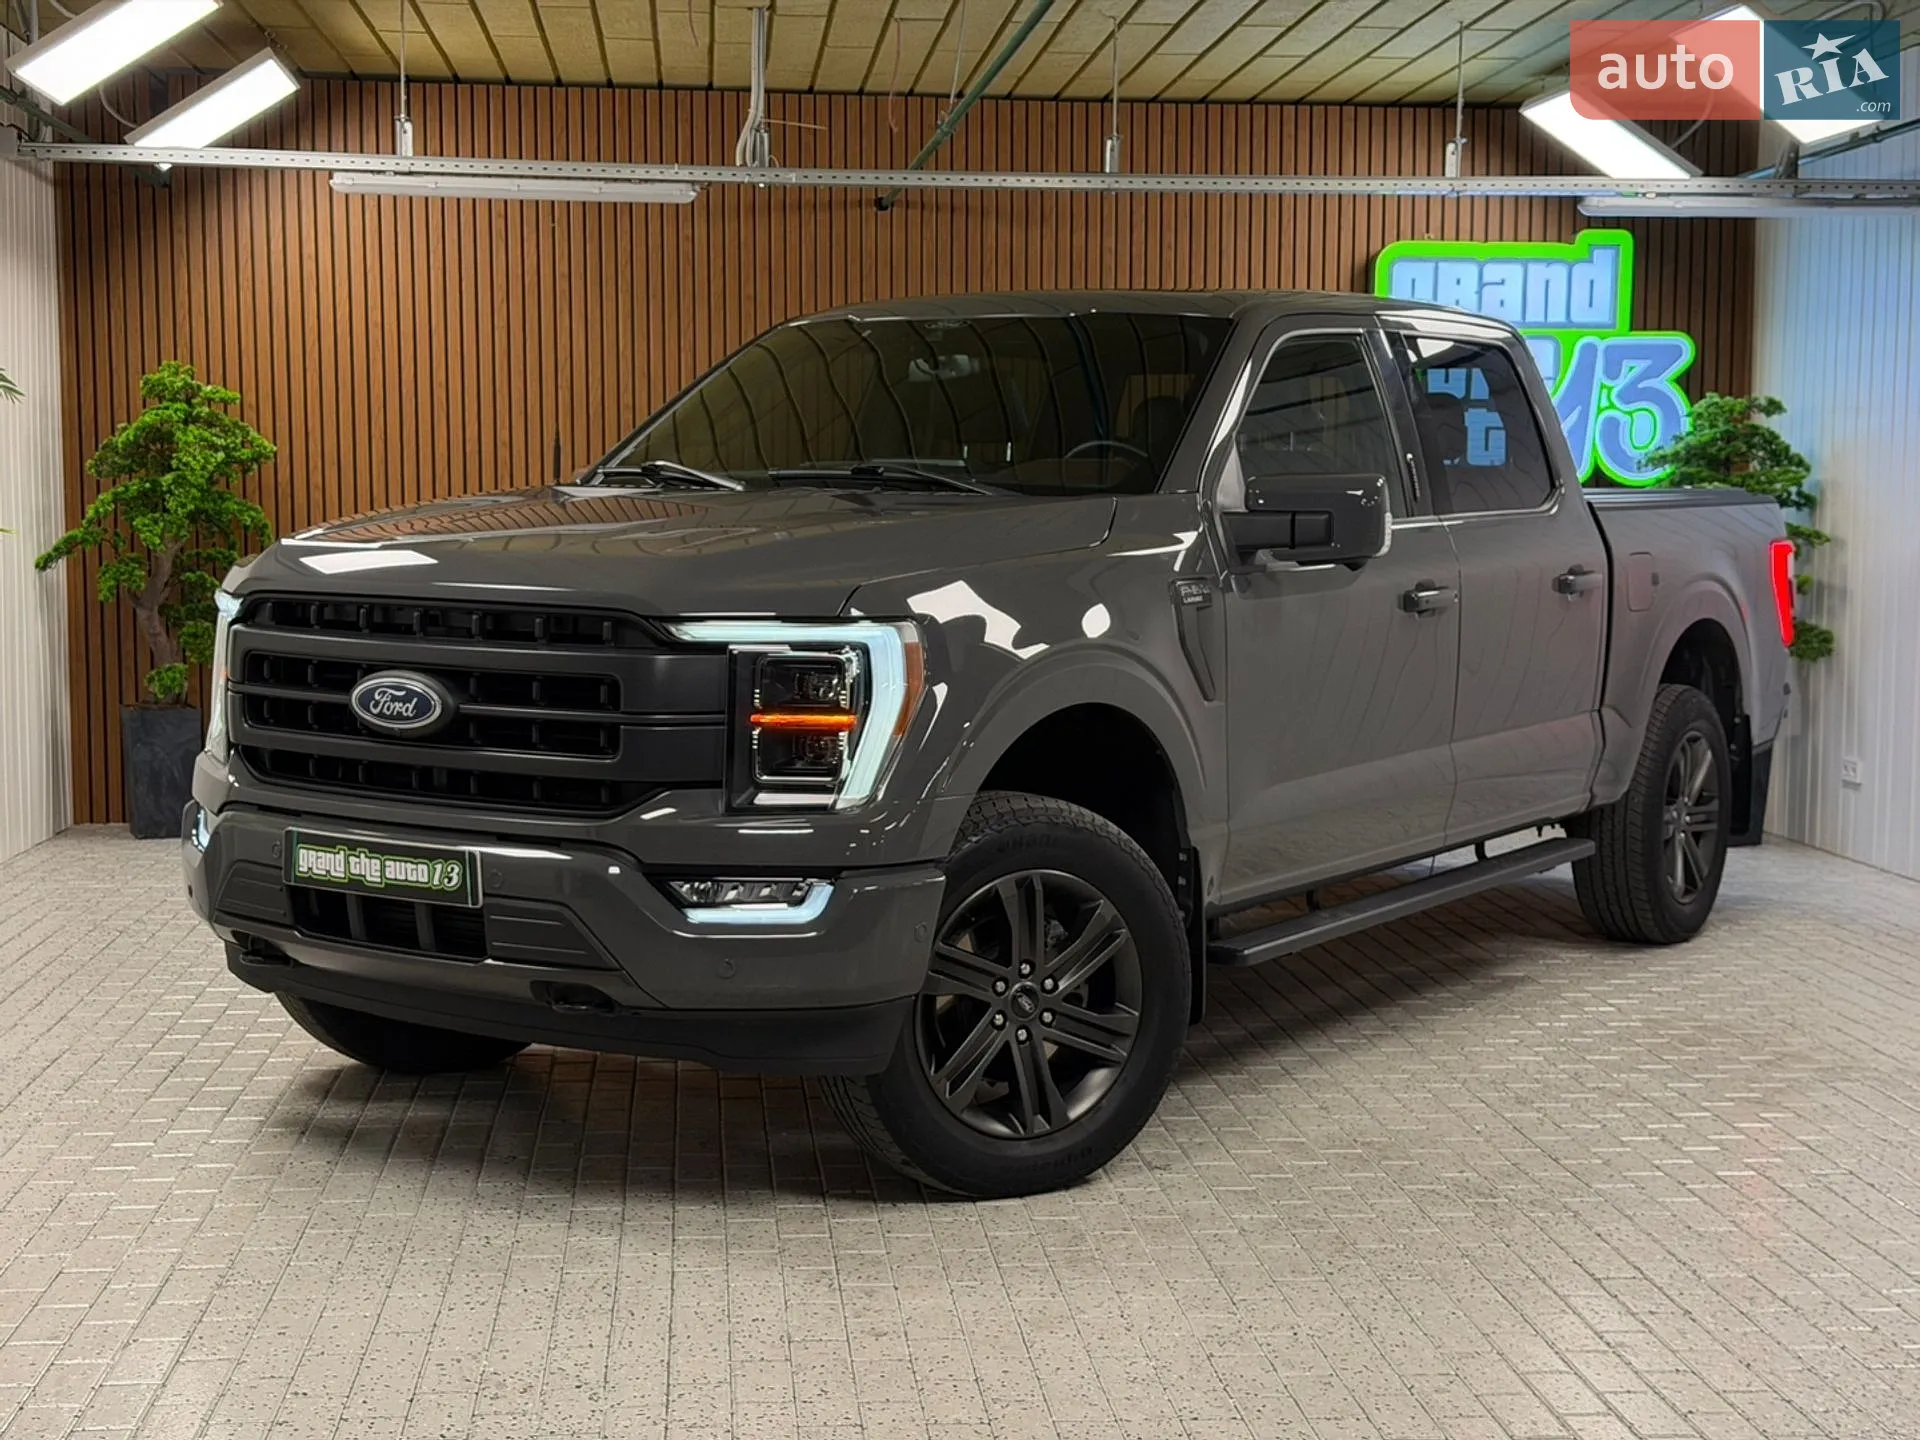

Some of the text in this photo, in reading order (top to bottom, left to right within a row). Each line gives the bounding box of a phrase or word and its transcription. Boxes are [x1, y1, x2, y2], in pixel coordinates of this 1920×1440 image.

[370, 687, 418, 717] Ford
[298, 848, 460, 887] grand the auto 13
